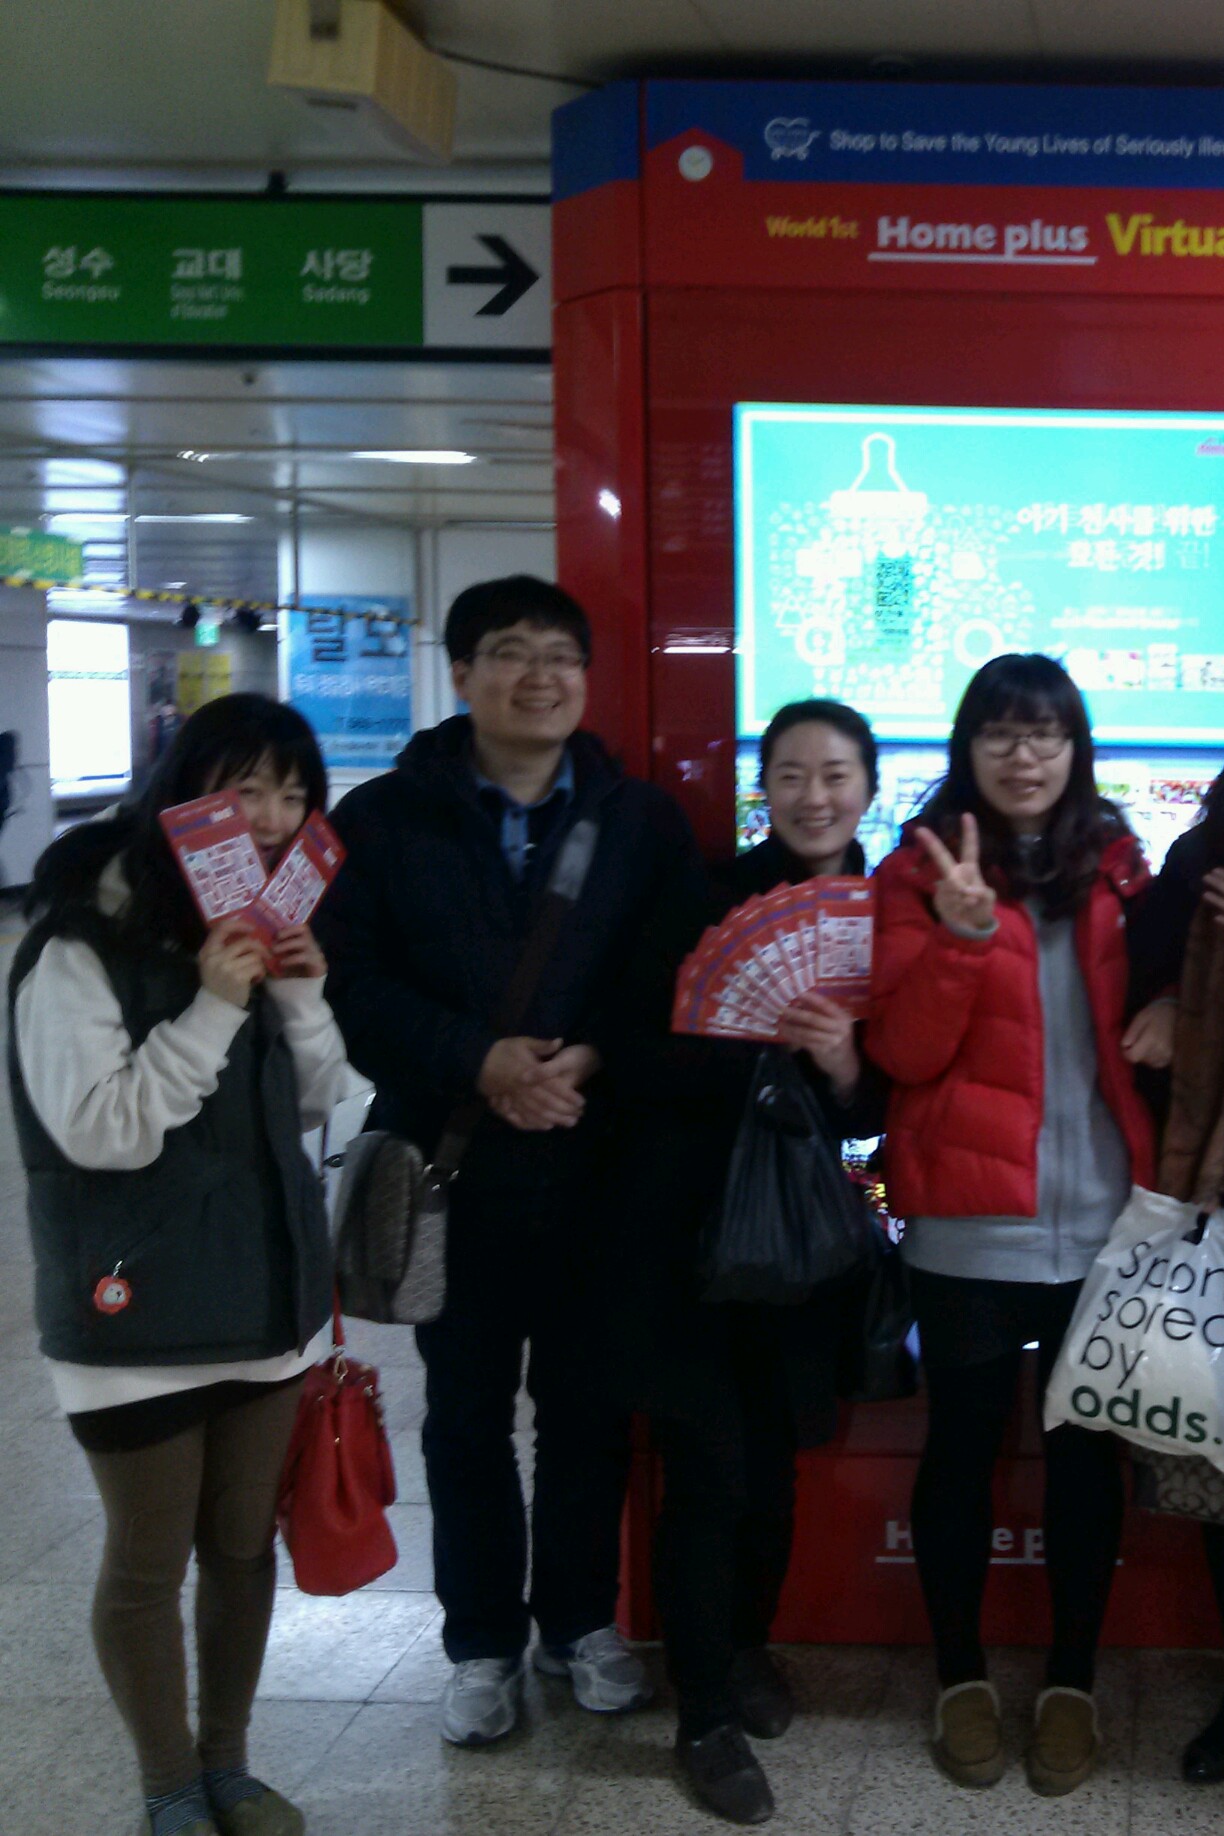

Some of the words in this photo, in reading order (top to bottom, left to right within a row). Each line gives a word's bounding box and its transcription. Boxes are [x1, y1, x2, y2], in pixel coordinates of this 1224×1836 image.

[830, 129, 876, 152] Shop
[880, 132, 898, 151] to
[902, 130, 947, 152] Save
[951, 132, 980, 152] the
[983, 132, 1039, 157] Young
[1043, 133, 1090, 154] Lives
[1092, 134, 1113, 154] of
[1116, 133, 1194, 158] Seriously
[876, 215, 997, 249] Home
[1005, 218, 1089, 259] plus
[172, 247, 244, 281] 교대
[300, 247, 373, 282] 사당
[1016, 502, 1068, 535] 아기
[1079, 1322, 1146, 1390] by
[1070, 1384, 1223, 1446] odds.
[885, 1520, 1014, 1551] He
